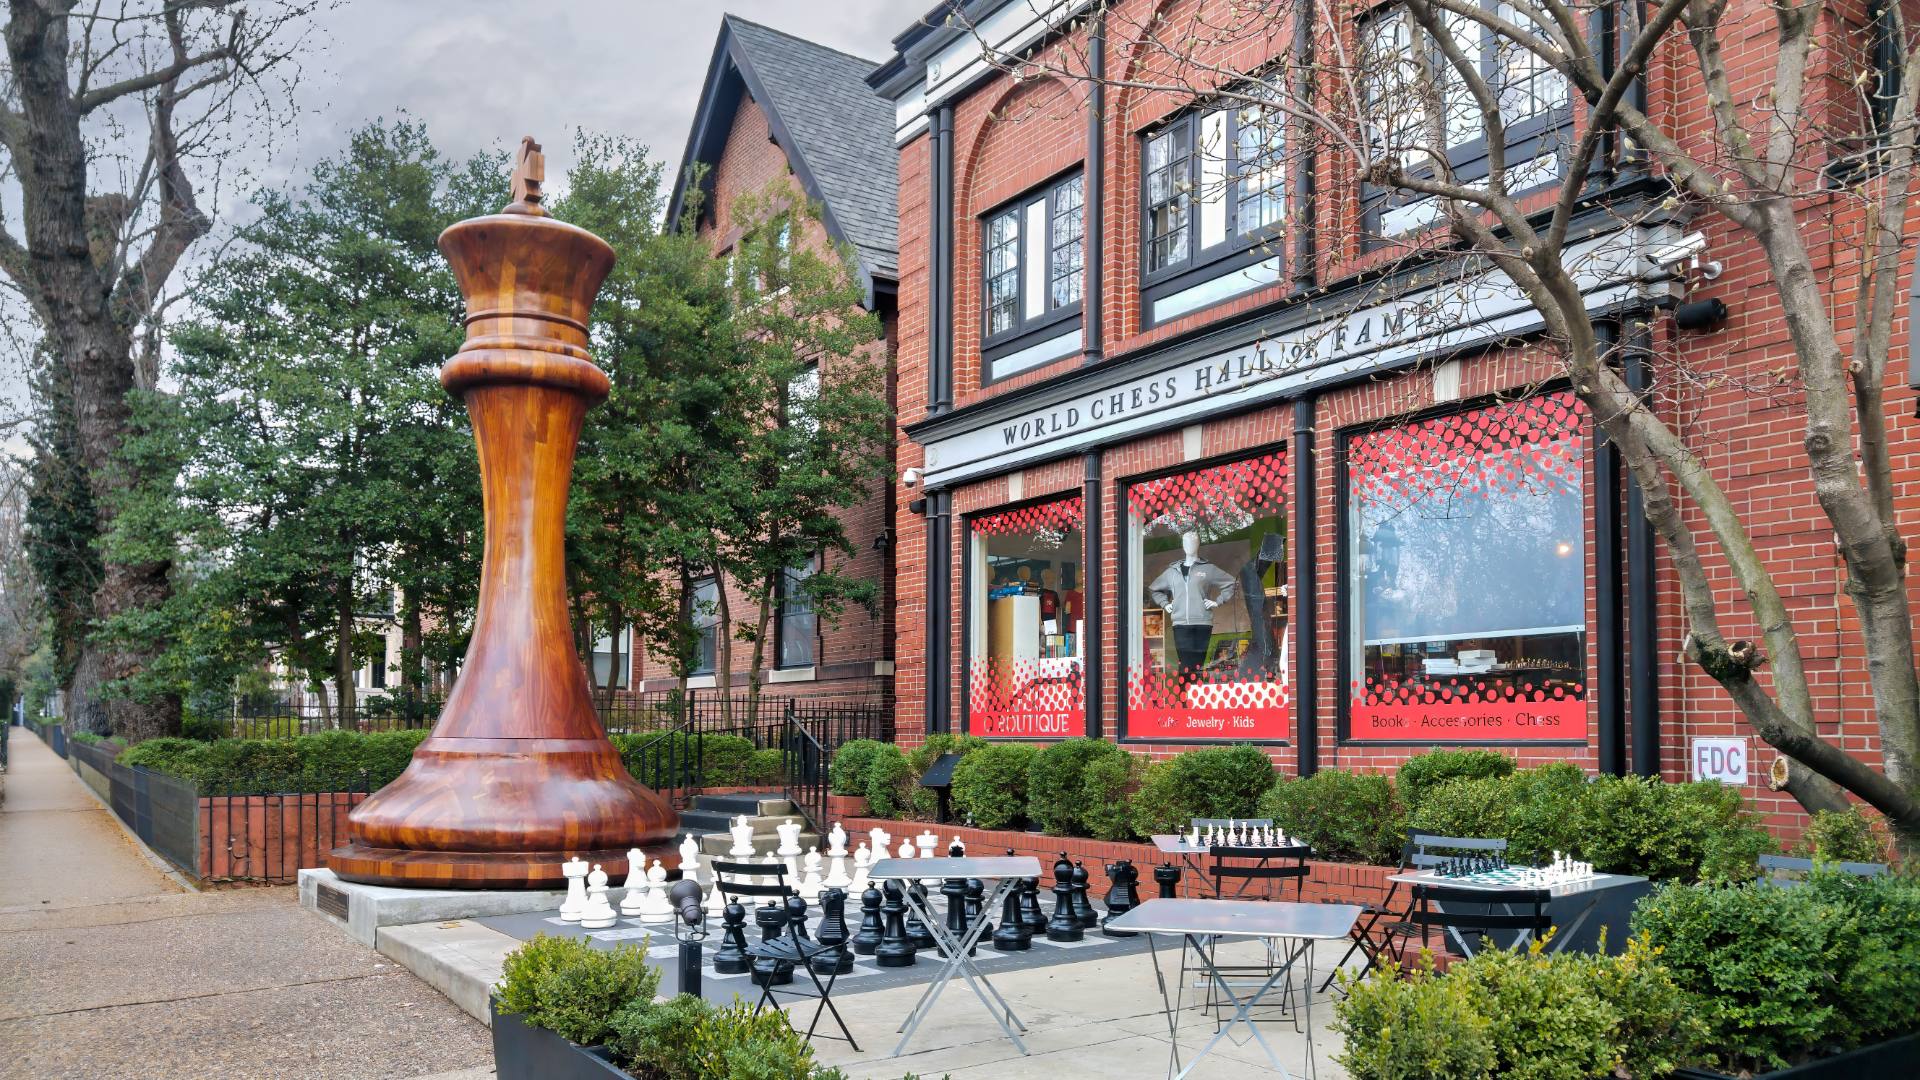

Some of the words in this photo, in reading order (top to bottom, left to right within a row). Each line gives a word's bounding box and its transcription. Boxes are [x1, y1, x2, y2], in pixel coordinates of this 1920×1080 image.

[1003, 408, 1080, 446] WORLD
[1091, 376, 1177, 420] CHESS
[1195, 349, 1273, 391] HALL
[1333, 299, 1434, 351] FAME
[998, 714, 1070, 733] BOUTIQUE
[1186, 716, 1225, 731] Jewelry
[1233, 716, 1255, 728] Kids
[1515, 712, 1560, 727] Chess
[1697, 746, 1741, 776] FDC
